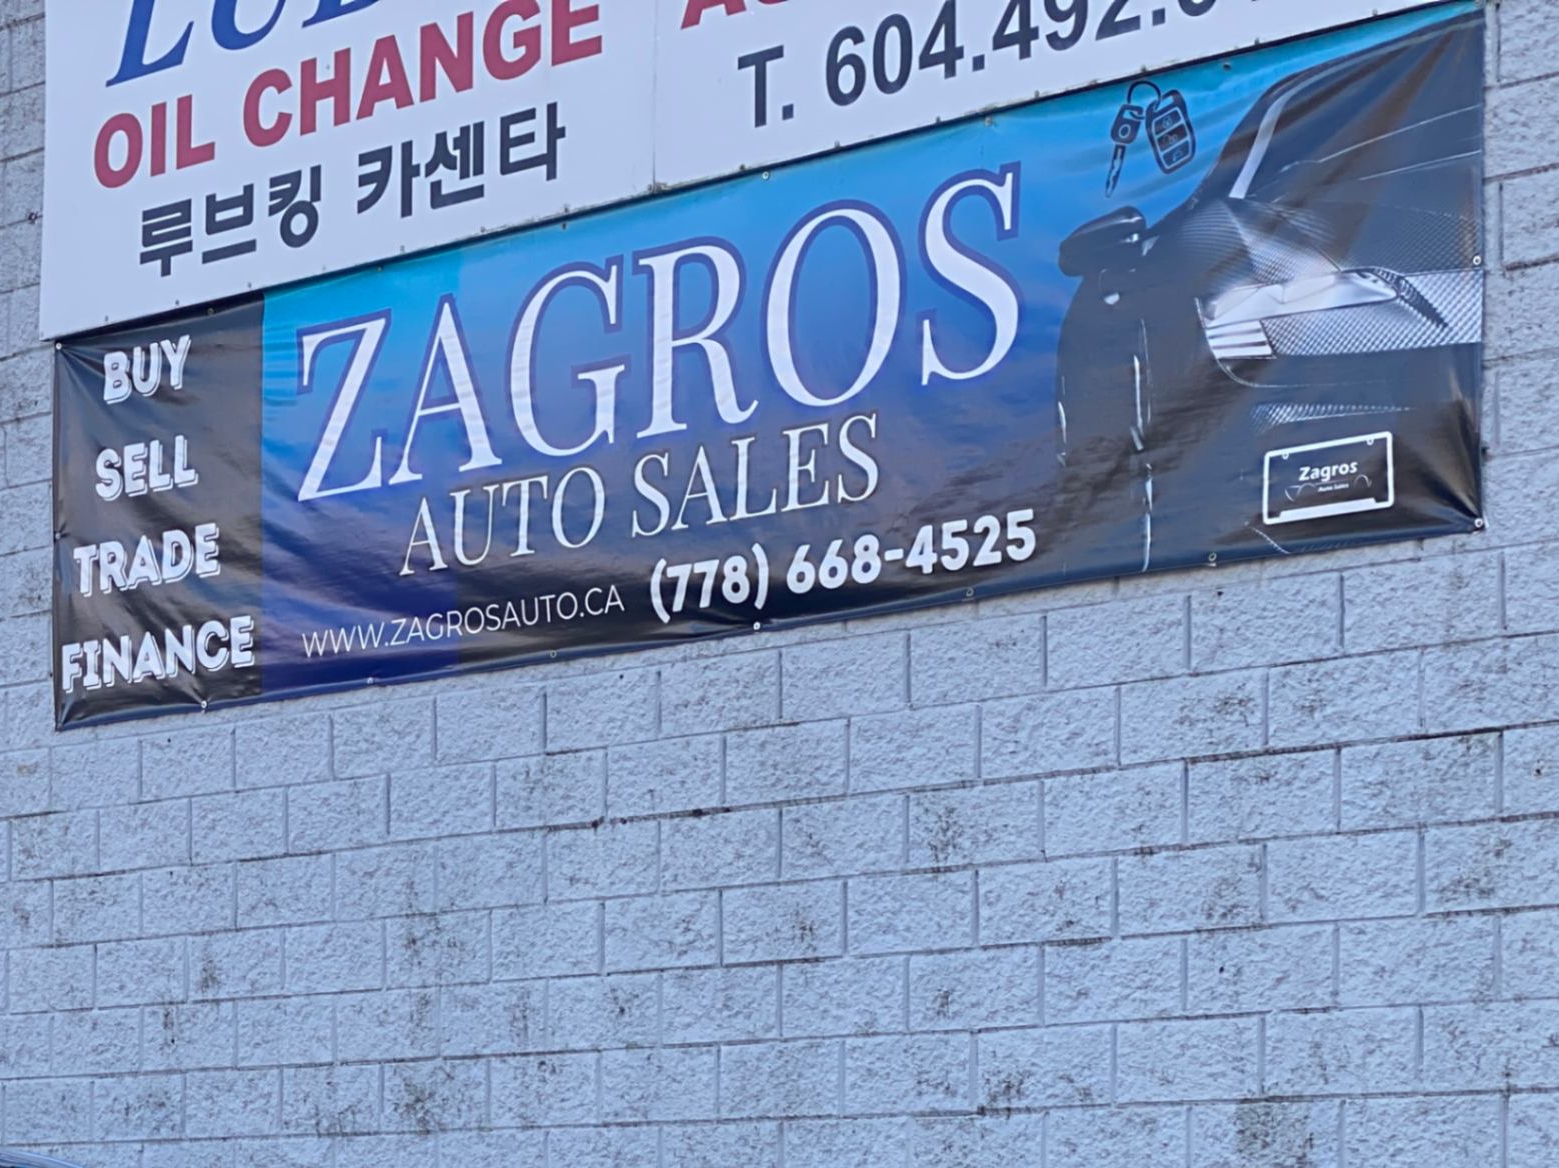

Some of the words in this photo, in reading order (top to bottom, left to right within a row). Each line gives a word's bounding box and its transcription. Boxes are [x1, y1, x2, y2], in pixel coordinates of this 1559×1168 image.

[93, 94, 216, 189] OIL
[242, 0, 603, 148] CHANGE
[738, 45, 795, 128] T.
[825, 0, 1218, 107] 604.492.
[139, 164, 322, 277] 루브킹
[357, 102, 566, 218] 카센타
[102, 334, 191, 404] BUY
[298, 170, 1021, 502] ZAGROS
[95, 435, 198, 501] SELL
[399, 467, 606, 576] AUTO
[631, 412, 879, 538] SALES
[1299, 461, 1358, 482] Zagros
[73, 522, 222, 597] TRADE
[301, 584, 625, 658] WWW.ZAGROSAUTO.CA
[650, 543, 769, 624] (778)
[786, 509, 1037, 596] 668-4525
[61, 615, 255, 692] FINANCE
